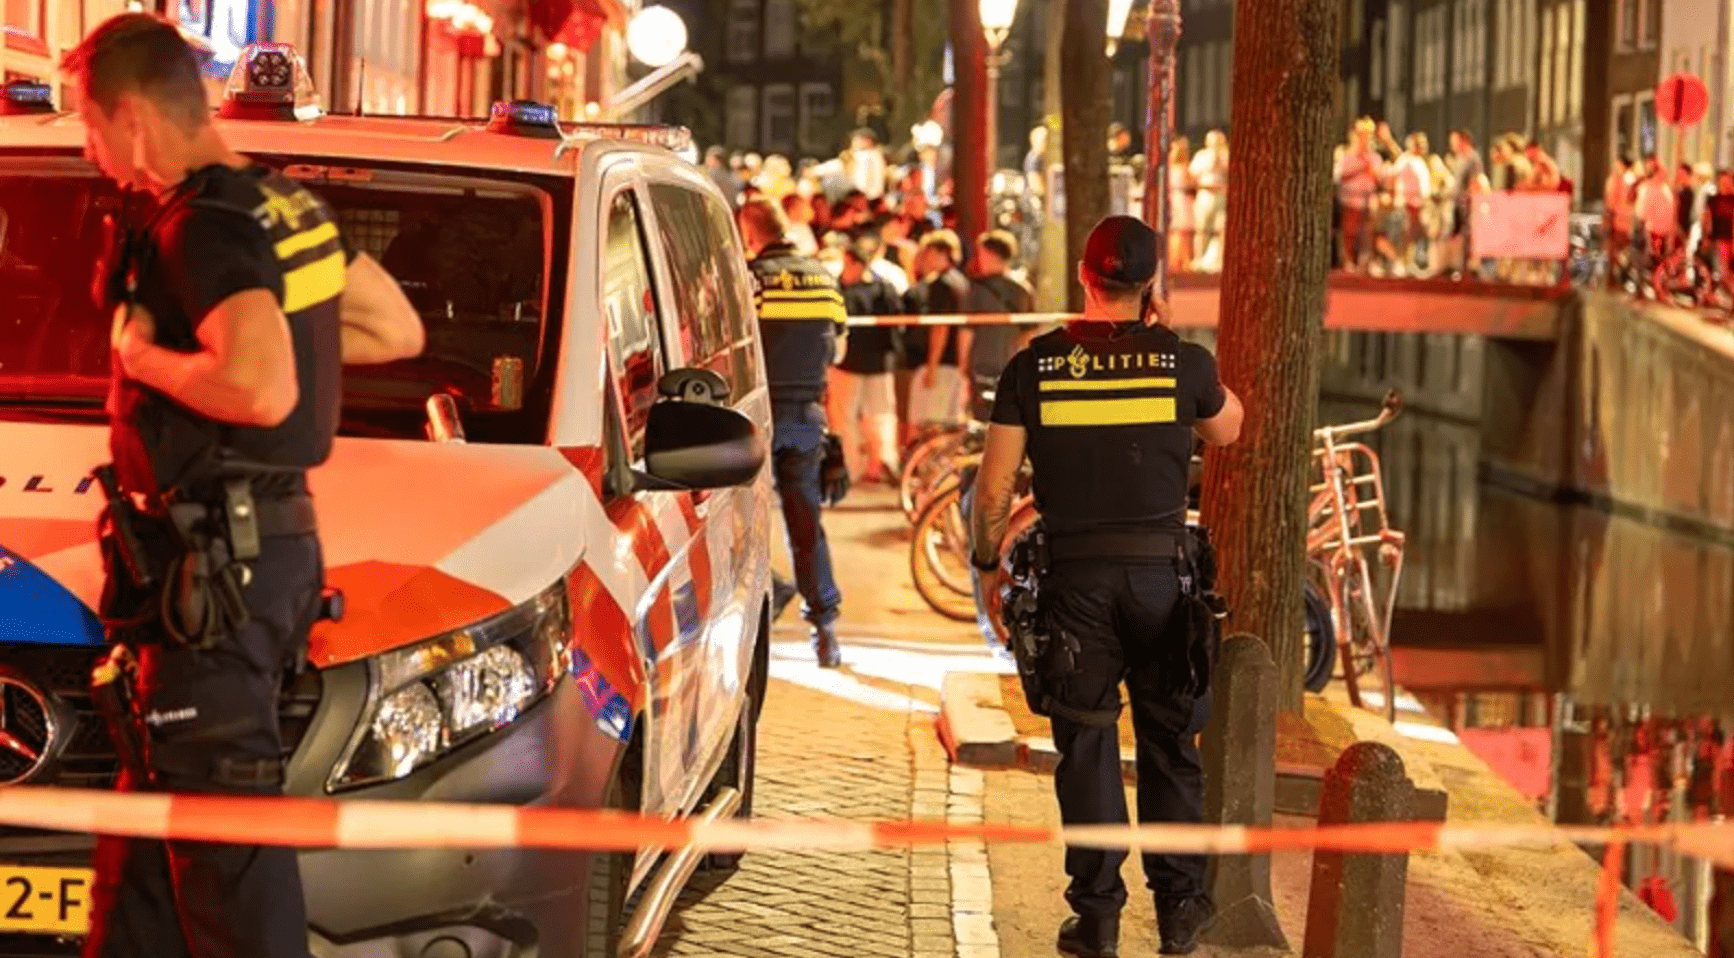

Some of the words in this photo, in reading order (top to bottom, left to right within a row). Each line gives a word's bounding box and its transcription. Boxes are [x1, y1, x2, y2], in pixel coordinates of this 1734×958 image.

[1054, 347, 1160, 377] POLITIE
[0, 475, 94, 494] LI
[5, 876, 85, 921] 2-F
